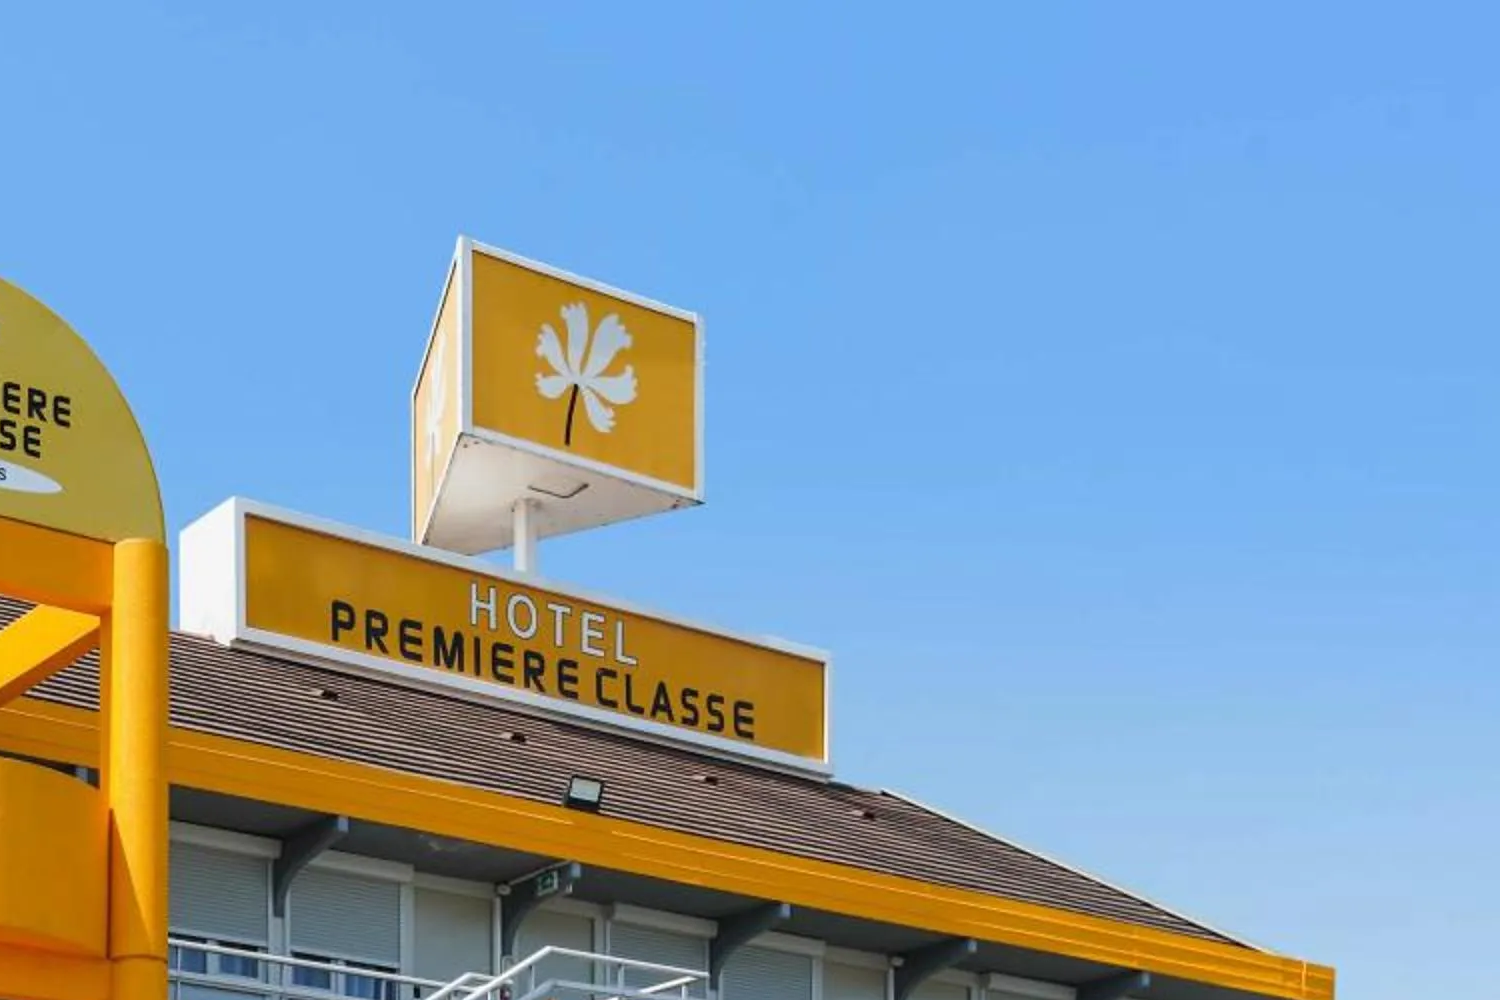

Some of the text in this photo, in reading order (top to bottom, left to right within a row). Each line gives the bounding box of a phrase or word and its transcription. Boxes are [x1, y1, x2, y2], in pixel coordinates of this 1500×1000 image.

[330, 600, 756, 740] PREMIERE CLASSE
[468, 581, 639, 667] HOTEL
